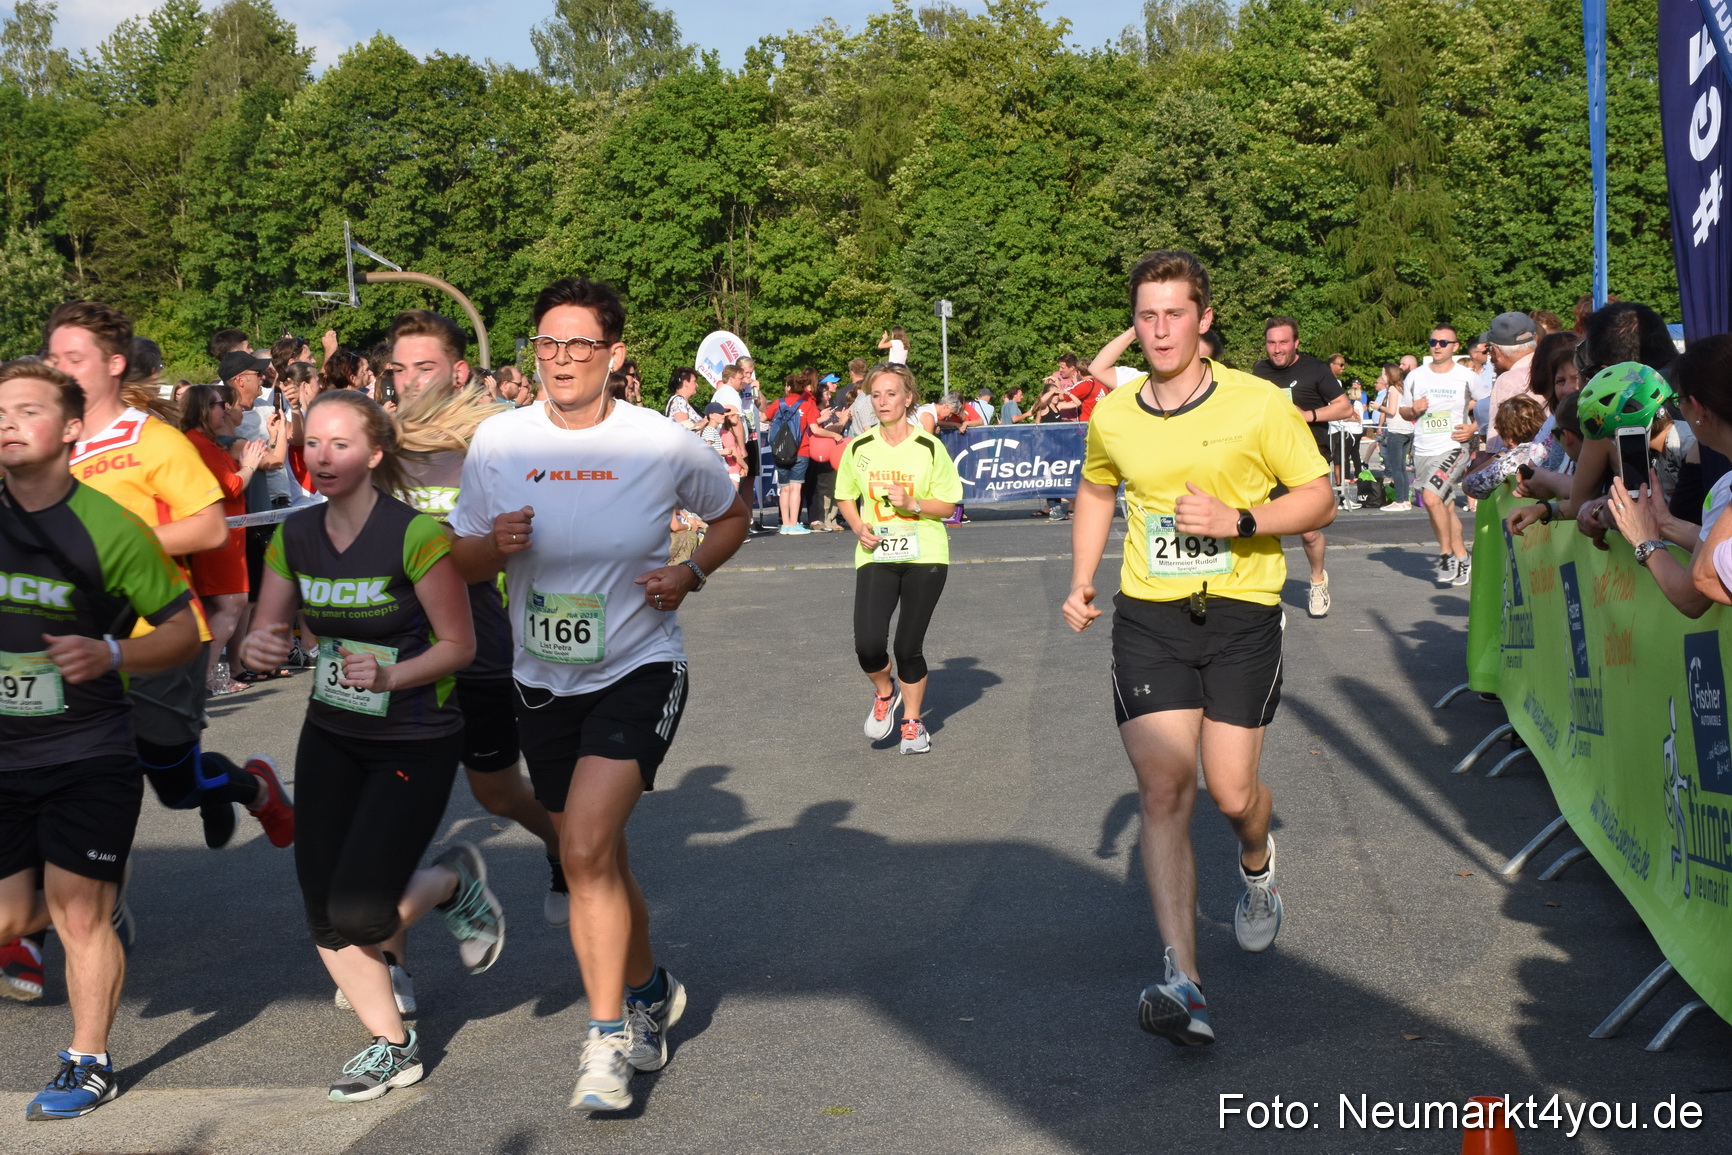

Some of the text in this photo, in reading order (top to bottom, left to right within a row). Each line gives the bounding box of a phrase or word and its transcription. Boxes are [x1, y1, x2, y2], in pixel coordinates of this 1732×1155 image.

[1425, 418, 1448, 428] 1003
[82, 453, 142, 481] BÖGL
[975, 456, 1081, 479] Fischer
[549, 470, 619, 481] KLEBL
[868, 470, 915, 481] Müller
[985, 478, 1073, 491] AUTOMOBILE
[880, 537, 909, 552] 672
[1154, 535, 1219, 559] 2193
[348, 603, 400, 619] concepts
[529, 613, 591, 645] 1166
[553, 643, 572, 652] Petra
[0, 675, 37, 699] 97
[1694, 683, 1721, 711] Fischer
[98, 853, 117, 862] JAKO
[1694, 873, 1729, 908] neumarkt
